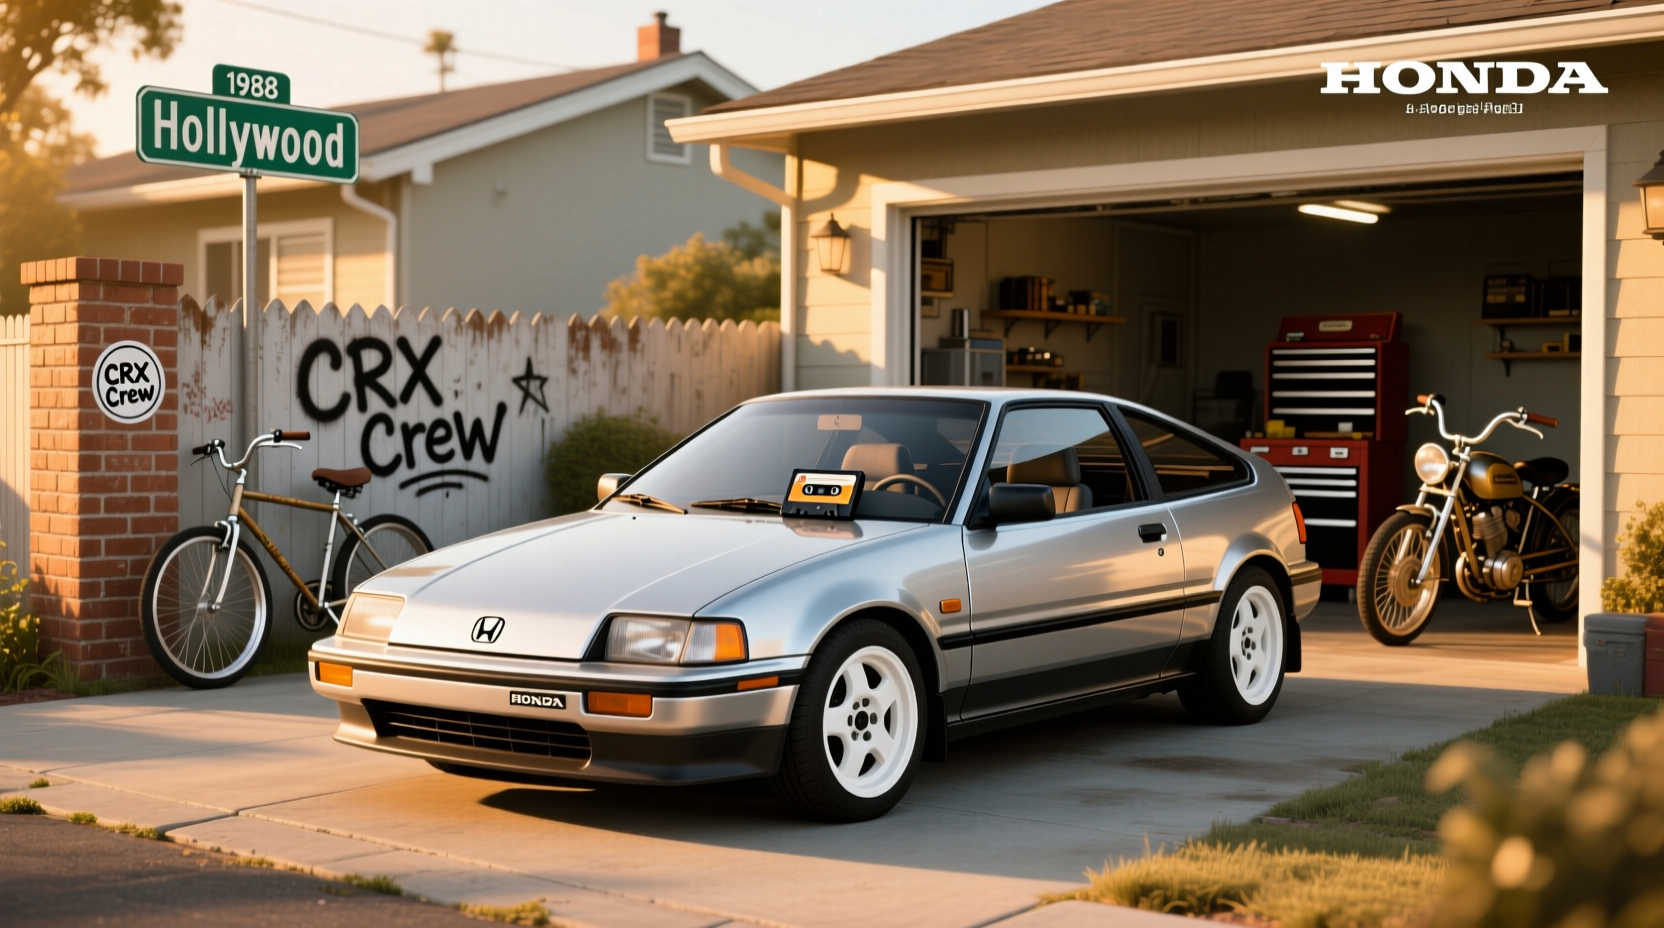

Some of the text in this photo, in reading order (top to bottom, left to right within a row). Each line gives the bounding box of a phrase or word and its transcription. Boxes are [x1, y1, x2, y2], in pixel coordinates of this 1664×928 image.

[226, 71, 279, 100] 1988
[154, 99, 344, 169] Hollywood
[104, 361, 150, 386] CRX
[296, 335, 444, 424] CRX
[105, 384, 155, 408] Crew
[360, 401, 508, 478] Crew
[511, 693, 564, 708] HONDA
